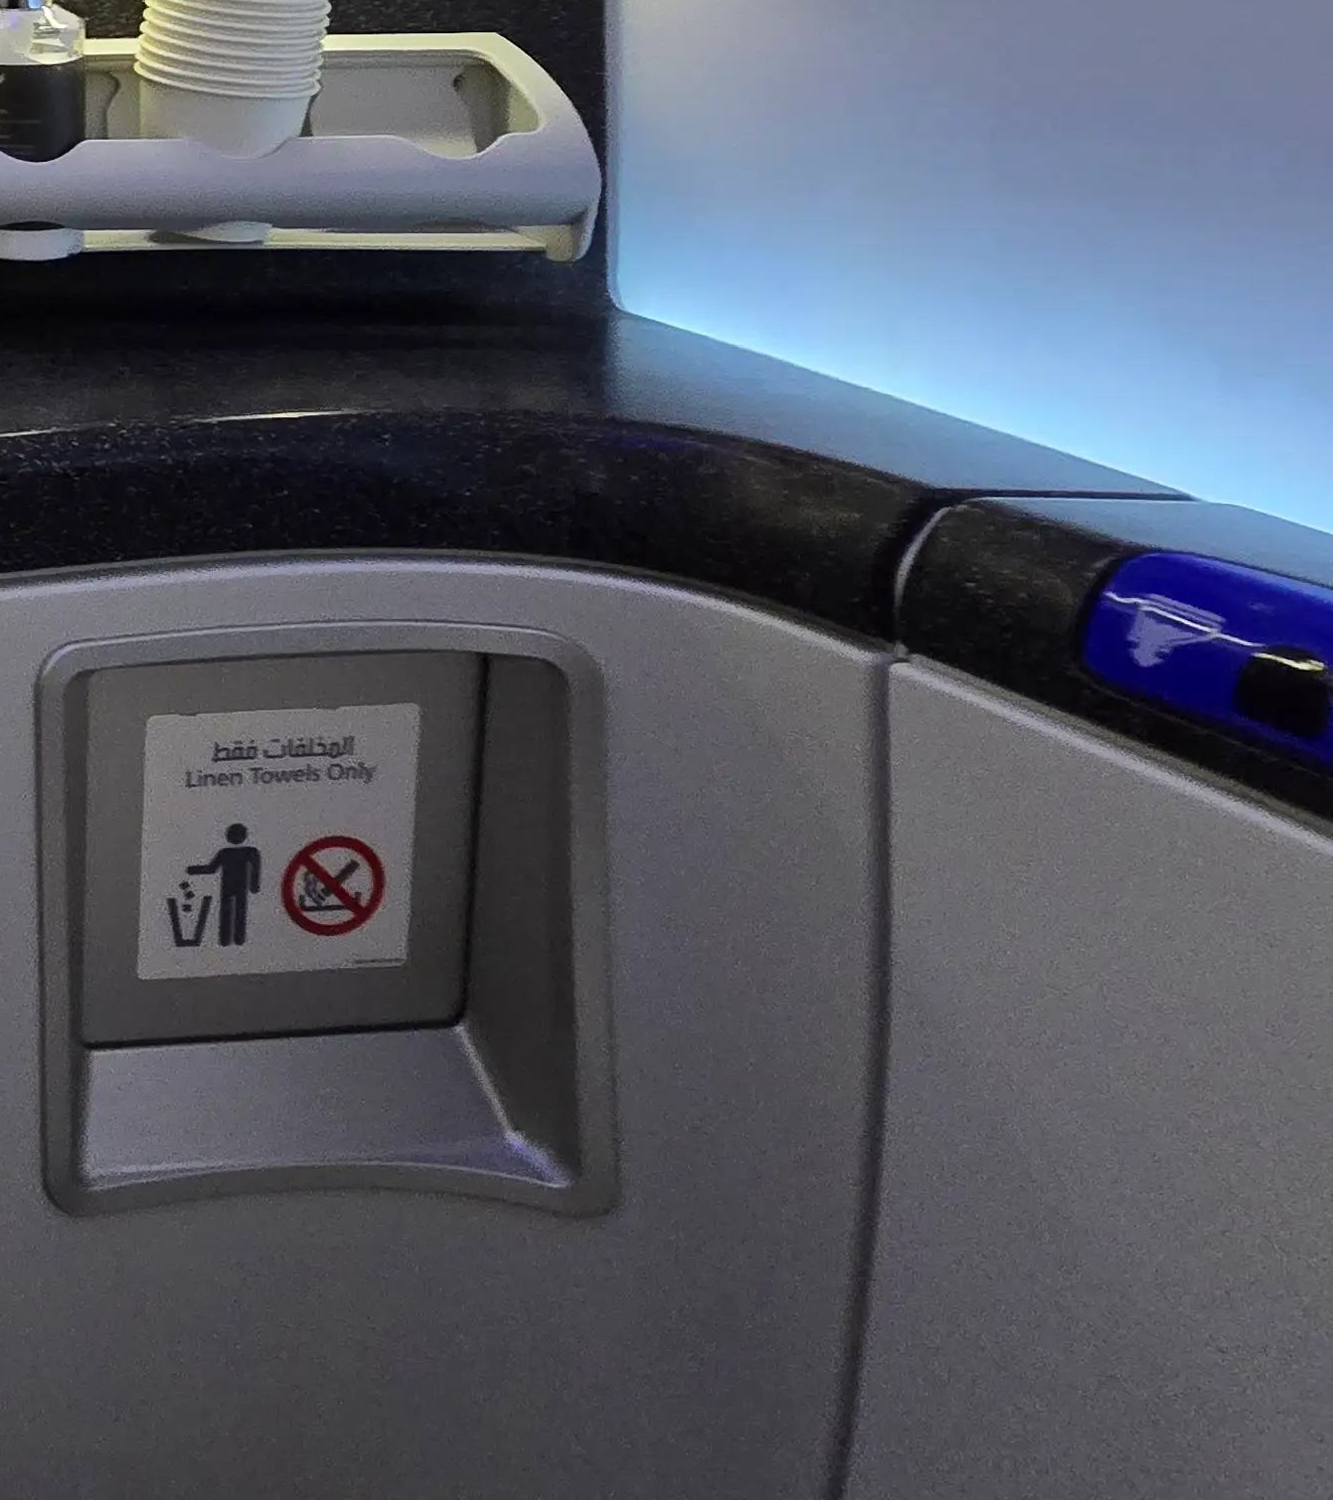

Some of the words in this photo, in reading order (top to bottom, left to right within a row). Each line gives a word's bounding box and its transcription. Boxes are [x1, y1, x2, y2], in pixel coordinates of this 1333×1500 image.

[211, 739, 258, 762] فقط
[184, 769, 243, 788] Linen
[248, 764, 321, 784] Towels
[327, 761, 378, 785] Only
